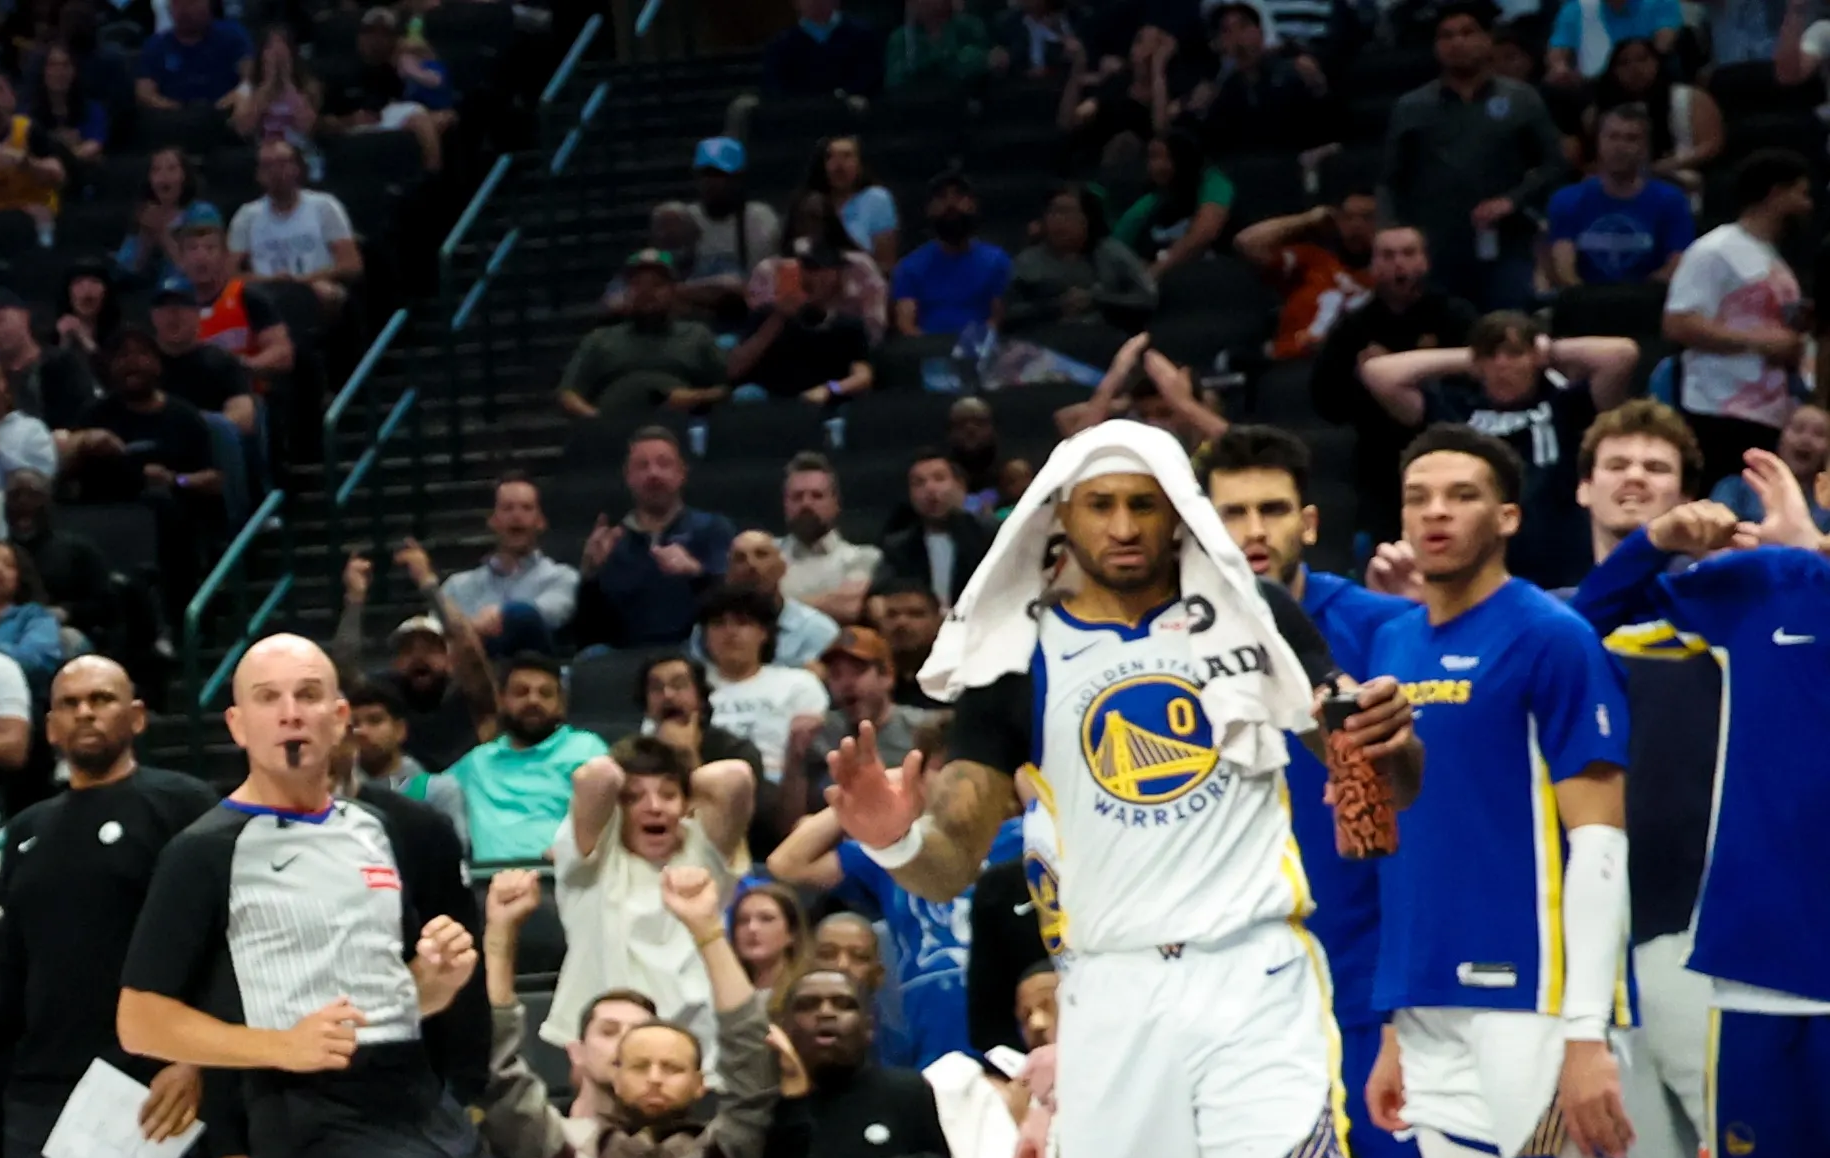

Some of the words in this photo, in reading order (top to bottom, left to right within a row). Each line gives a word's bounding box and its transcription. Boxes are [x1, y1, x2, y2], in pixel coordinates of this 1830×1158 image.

[1073, 659, 1145, 715] GOLDEN
[1167, 697, 1196, 735] 0
[1094, 768, 1231, 828] WARRIORS
